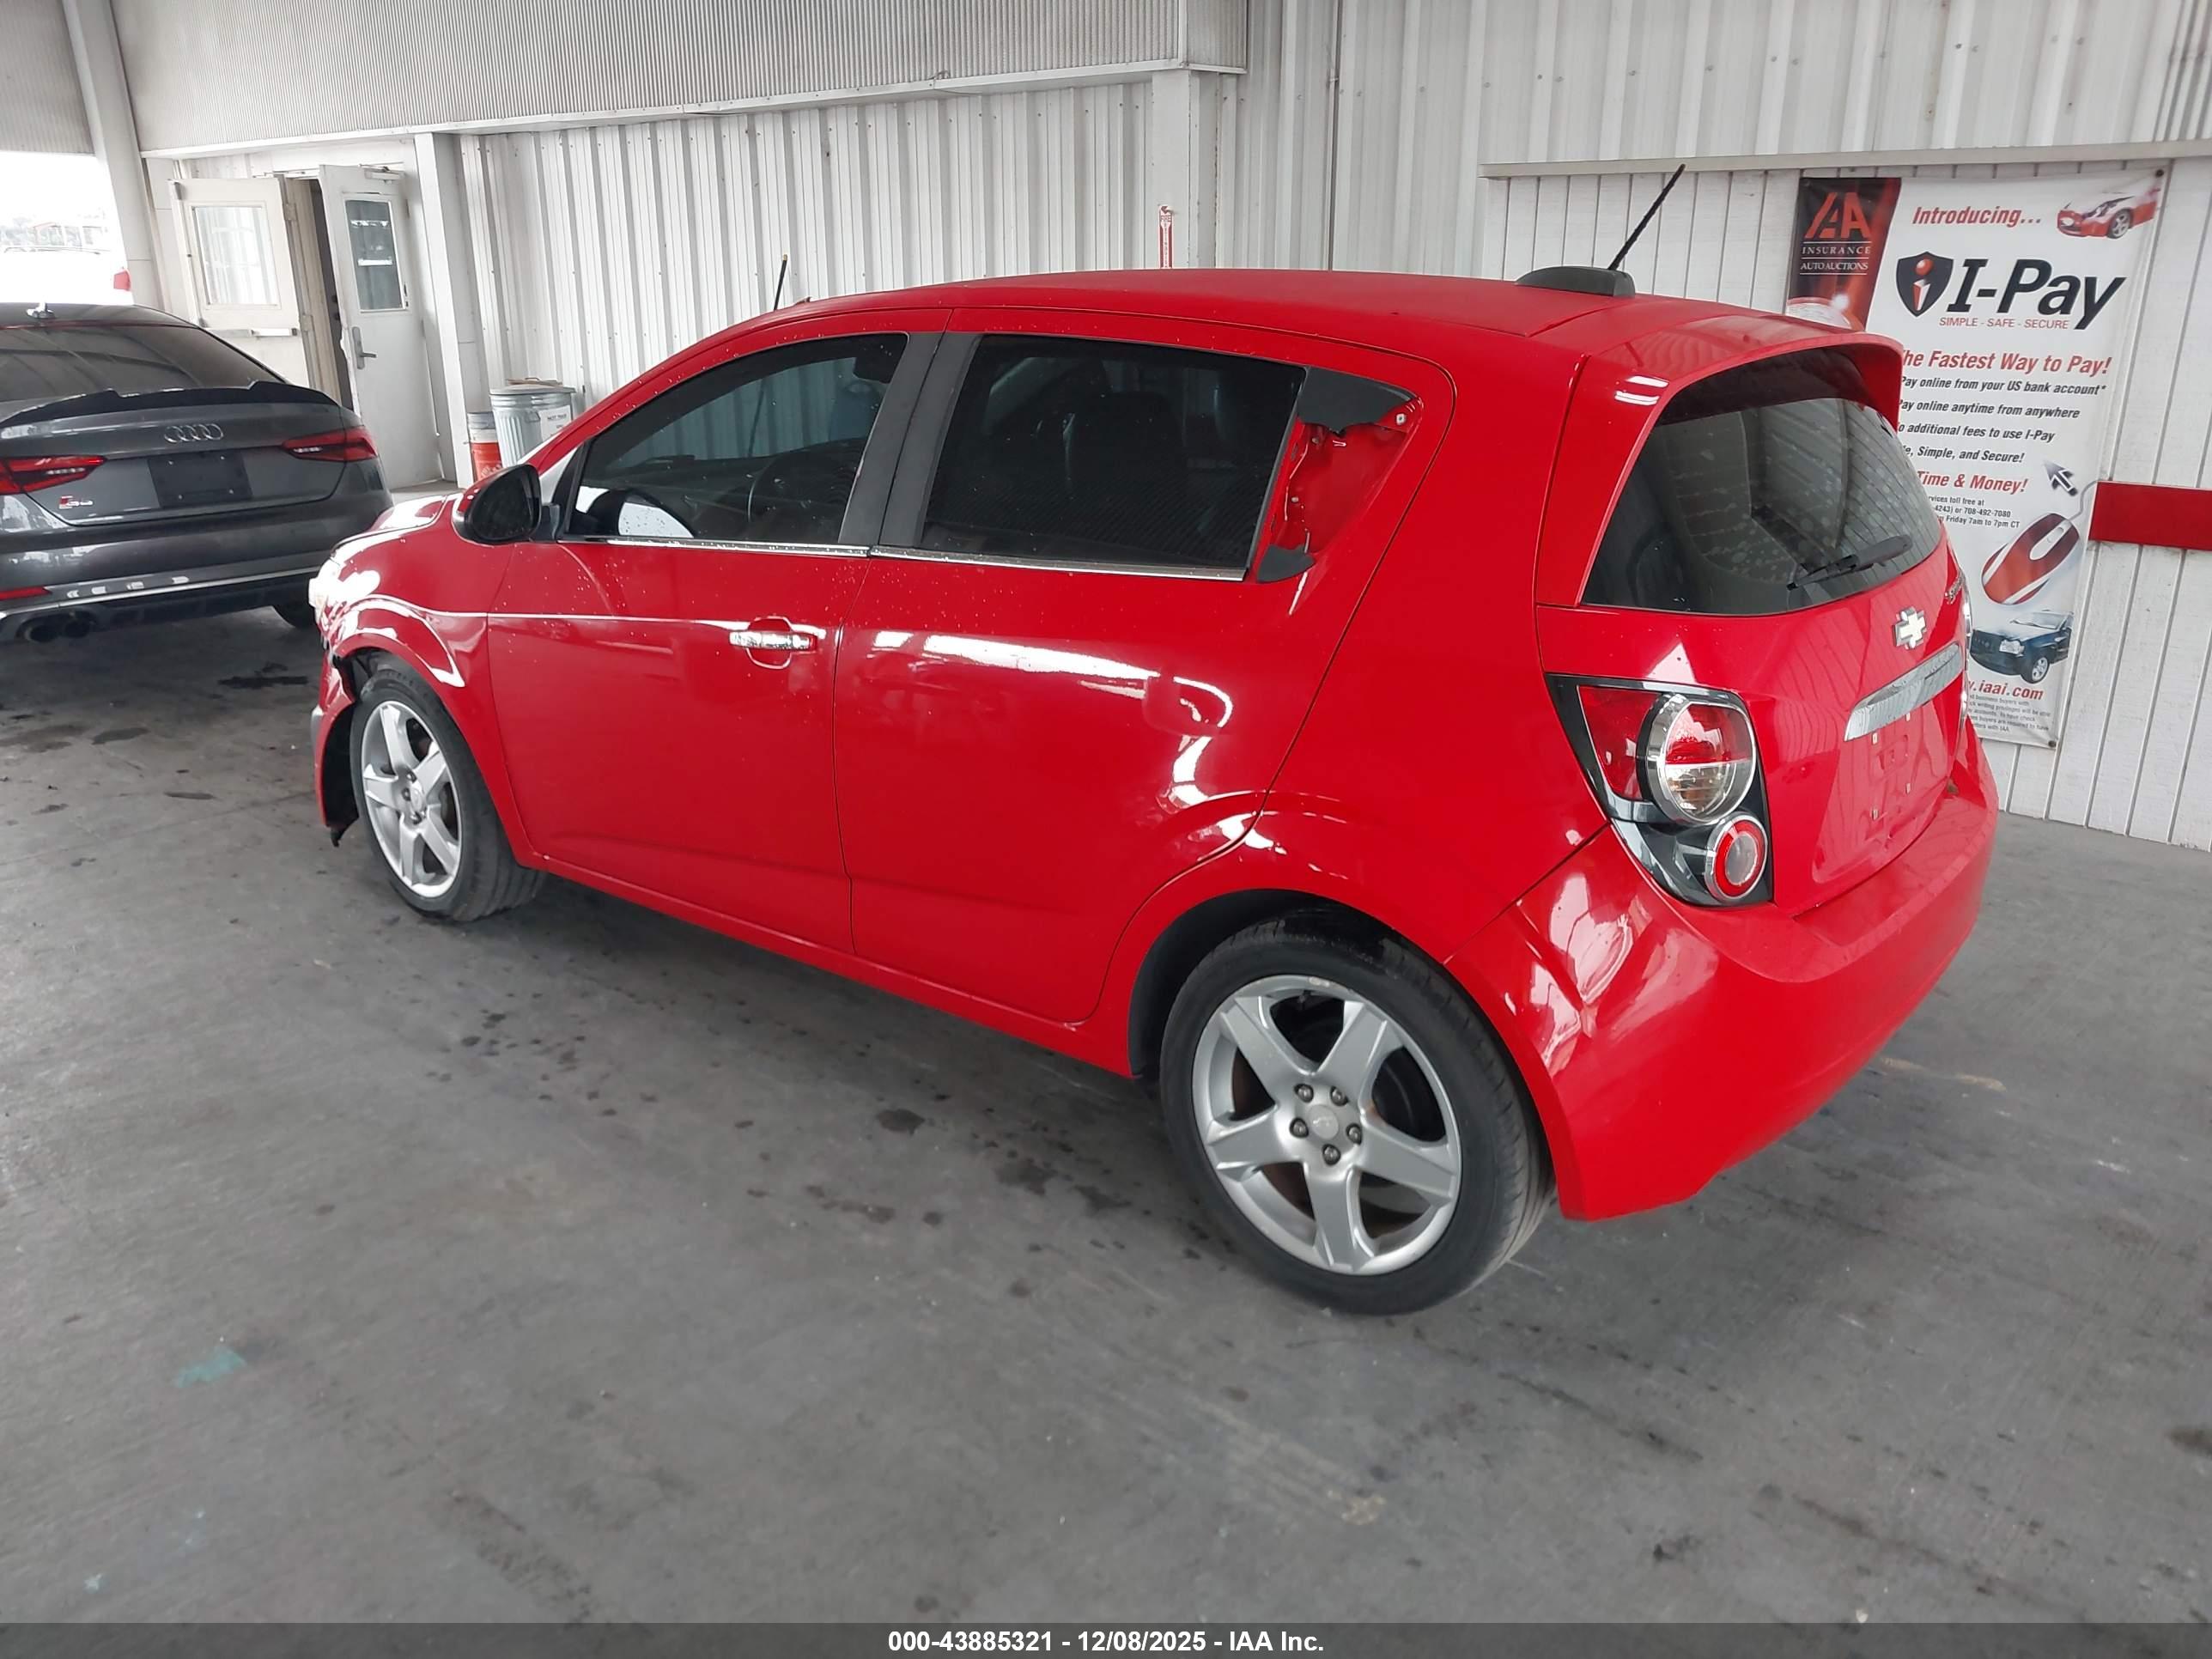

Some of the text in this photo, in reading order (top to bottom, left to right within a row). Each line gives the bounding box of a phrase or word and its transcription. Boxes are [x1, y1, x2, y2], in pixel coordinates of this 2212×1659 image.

[1912, 206, 2041, 228] Introducing...
[1802, 246, 1871, 255] INSURANCE
[1800, 262, 1869, 270] AUTO AUCTIONS
[1947, 258, 2127, 331] I-Pay
[1939, 317, 1978, 327] SIMPLE
[1987, 318, 2014, 328] SAFE
[2024, 319, 2070, 330] SECURE
[1903, 349, 2112, 378] he Fastest Way to Pay!
[1919, 377, 1952, 389] online
[1954, 378, 1978, 390] from
[1979, 381, 2005, 392] your
[2007, 380, 2022, 392] US
[2024, 381, 2051, 392] bank
[1916, 400, 1949, 412] online
[1951, 403, 1995, 415] anytime
[1997, 404, 2023, 416] from
[2025, 406, 2081, 419] anywhere
[1907, 422, 1961, 435] additional
[1962, 426, 1987, 437] fees
[1989, 427, 2000, 438] to
[2002, 429, 2022, 440] use
[2025, 428, 2056, 443] I-Pay
[1917, 446, 1955, 460] Simple,
[1959, 449, 1980, 460] and
[1981, 450, 2025, 463] Secure!
[1954, 473, 1966, 488] &
[1970, 475, 2029, 495] Money!
[1946, 515, 1967, 526] Friday
[1968, 516, 1983, 525] 7am
[1994, 519, 2008, 528] 7pm
